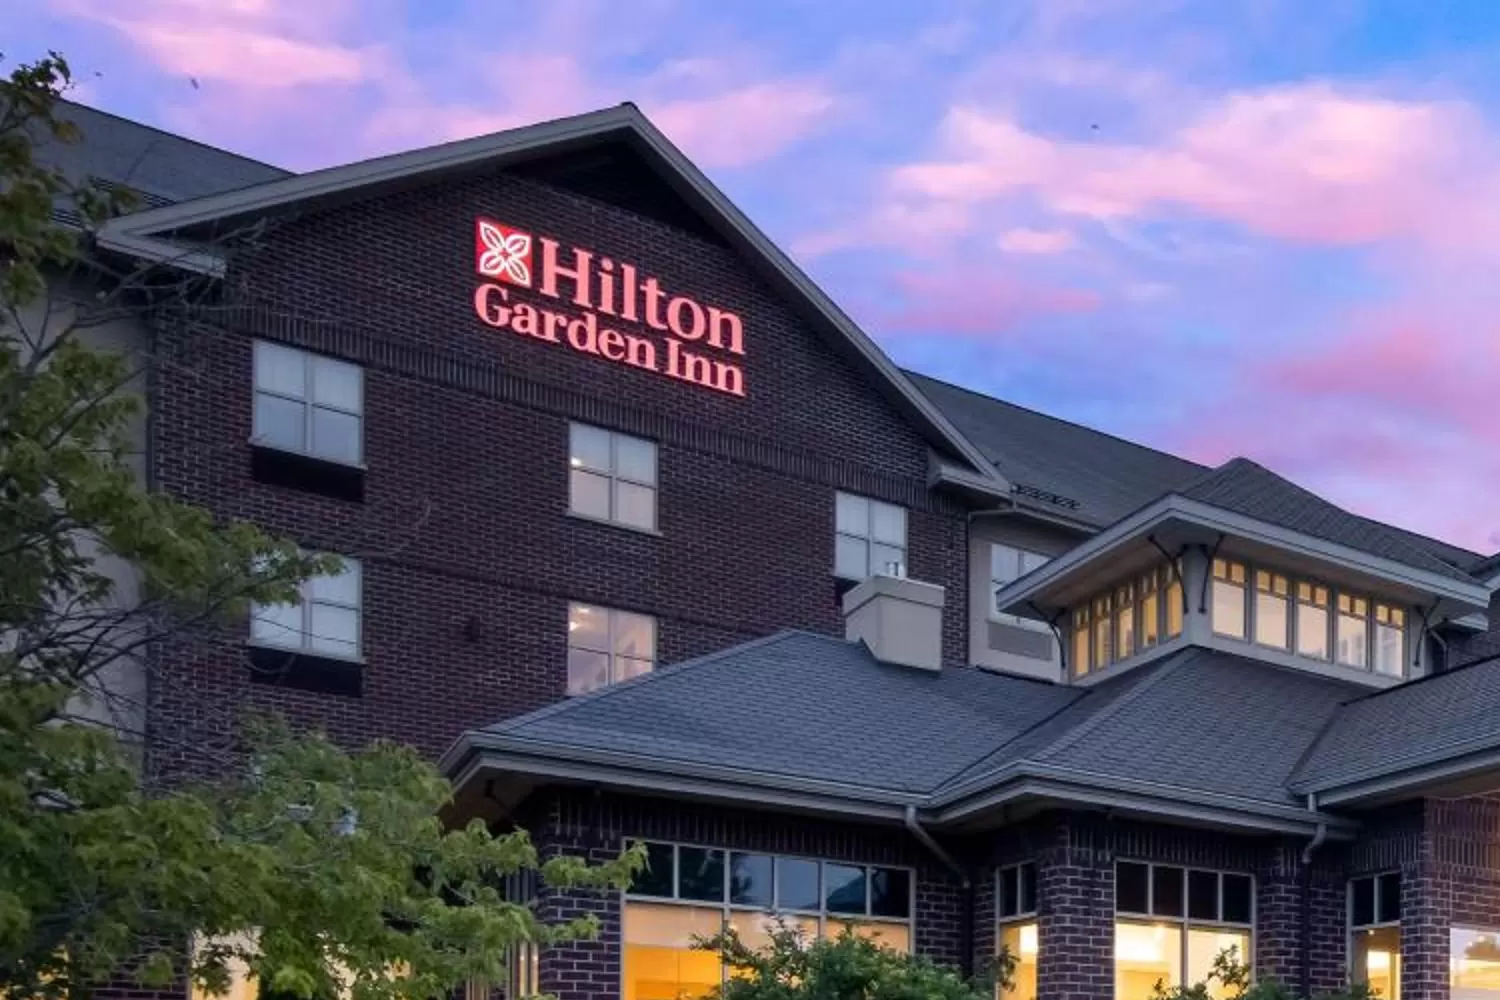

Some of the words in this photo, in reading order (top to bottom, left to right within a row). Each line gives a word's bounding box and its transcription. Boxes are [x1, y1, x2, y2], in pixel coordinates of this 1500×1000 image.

[474, 282, 659, 373] Garden
[664, 336, 745, 397] Inn
[538, 236, 746, 356] Hilton
